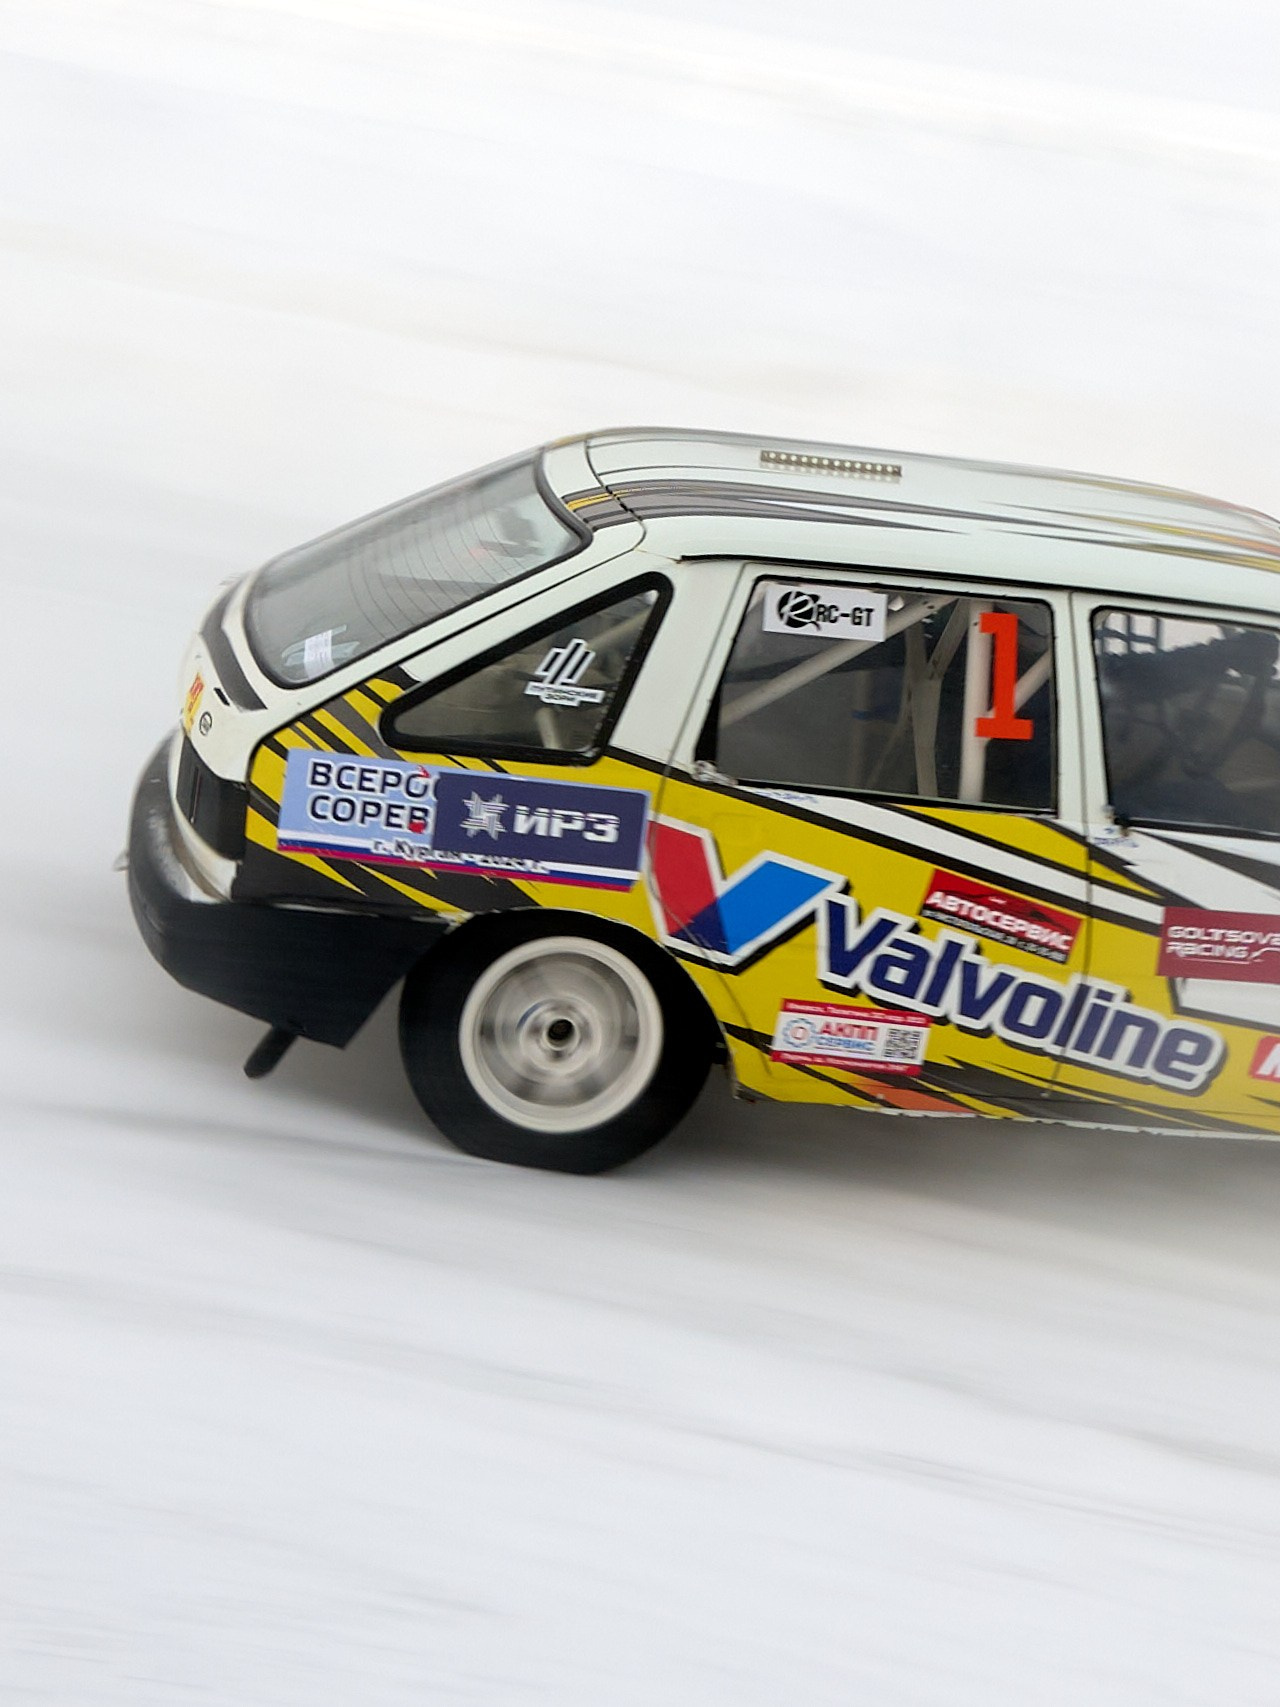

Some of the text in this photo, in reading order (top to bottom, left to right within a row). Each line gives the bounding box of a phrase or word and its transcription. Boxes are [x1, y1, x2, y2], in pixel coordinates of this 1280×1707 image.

[974, 611, 1034, 741] 1
[309, 760, 440, 801] ВСЕРО
[513, 804, 622, 844] ИРЗ
[924, 890, 1075, 951] АВТОСЕРВИС
[821, 894, 1220, 1089] Valvoline
[819, 1021, 880, 1041] АКПП
